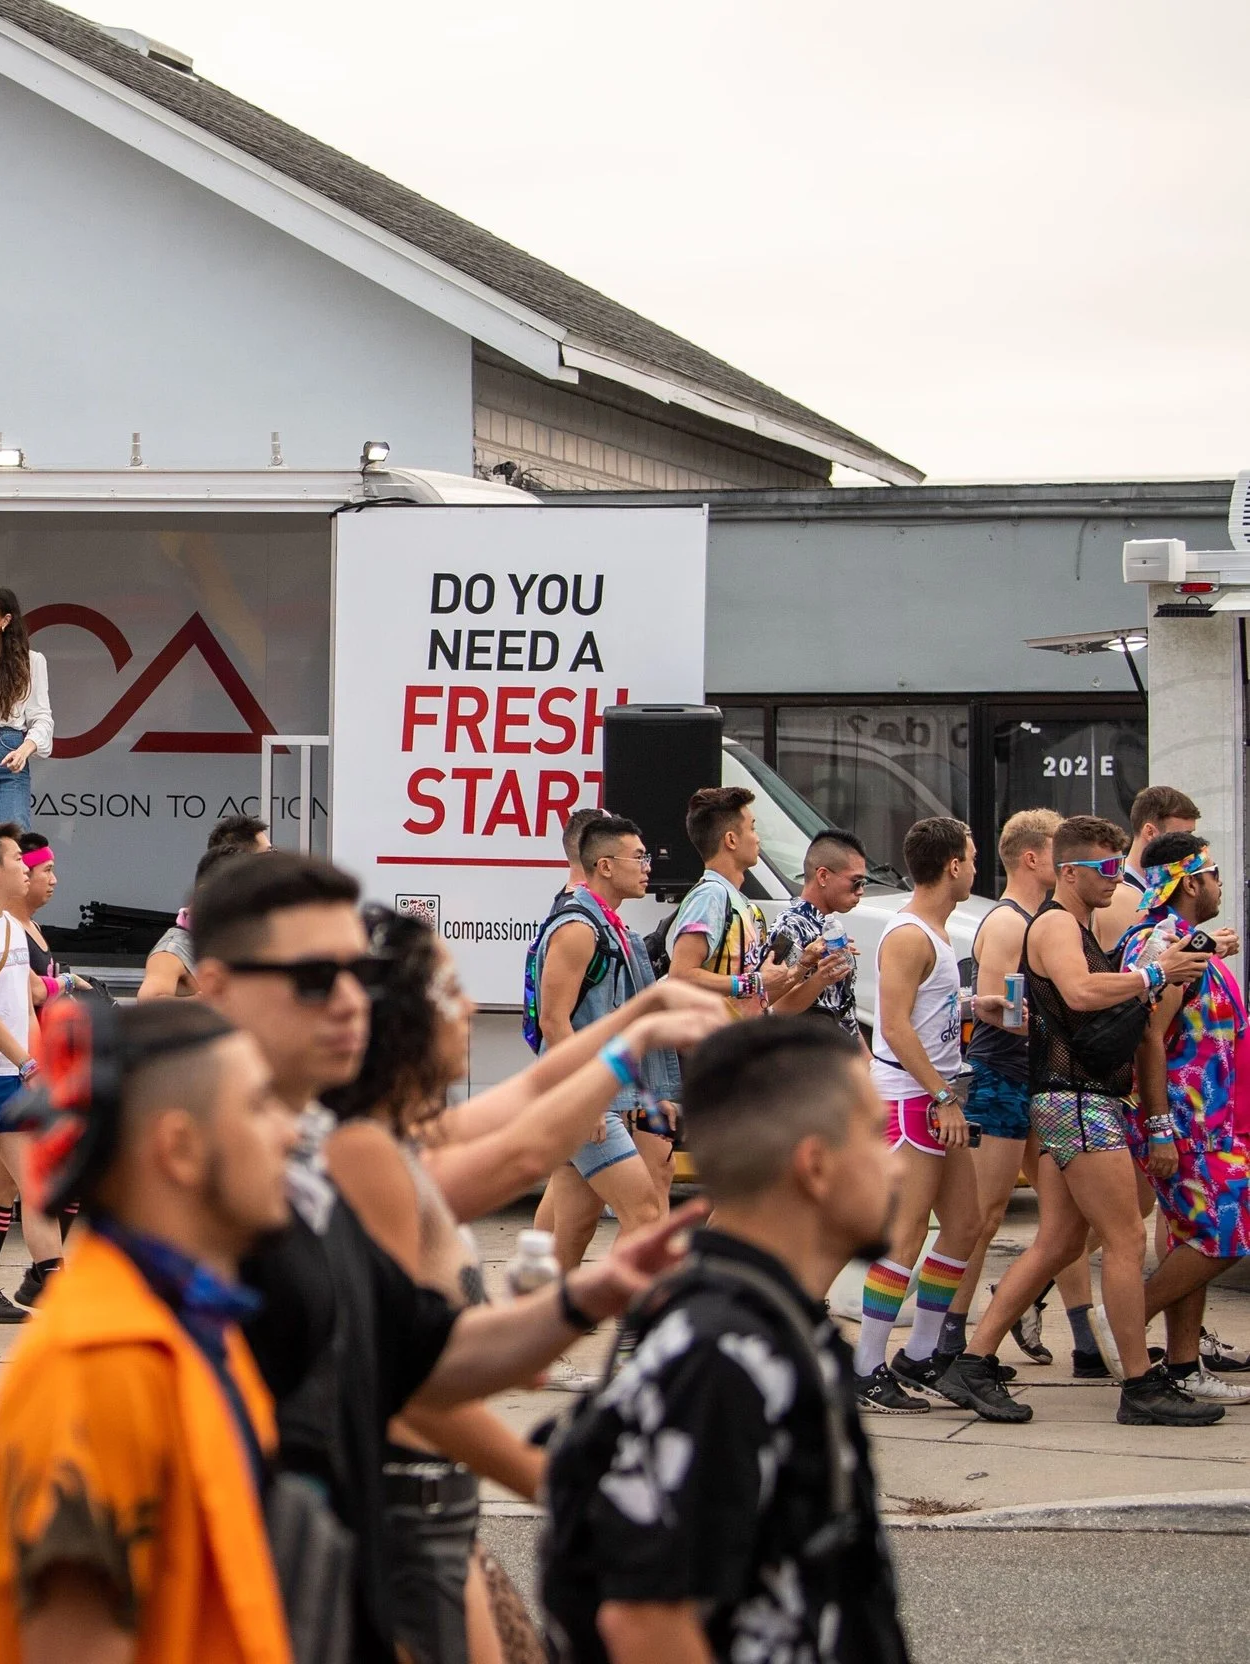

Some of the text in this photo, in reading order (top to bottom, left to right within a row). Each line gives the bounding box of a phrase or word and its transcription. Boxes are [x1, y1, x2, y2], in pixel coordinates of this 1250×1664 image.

[430, 572, 605, 616] DO YOU
[427, 629, 604, 673] NEED A
[401, 685, 628, 755] FRESH
[1043, 755, 1114, 777] 202 E
[30, 793, 151, 818] ASSION
[166, 795, 206, 818] TO
[444, 917, 539, 943] compassiont
